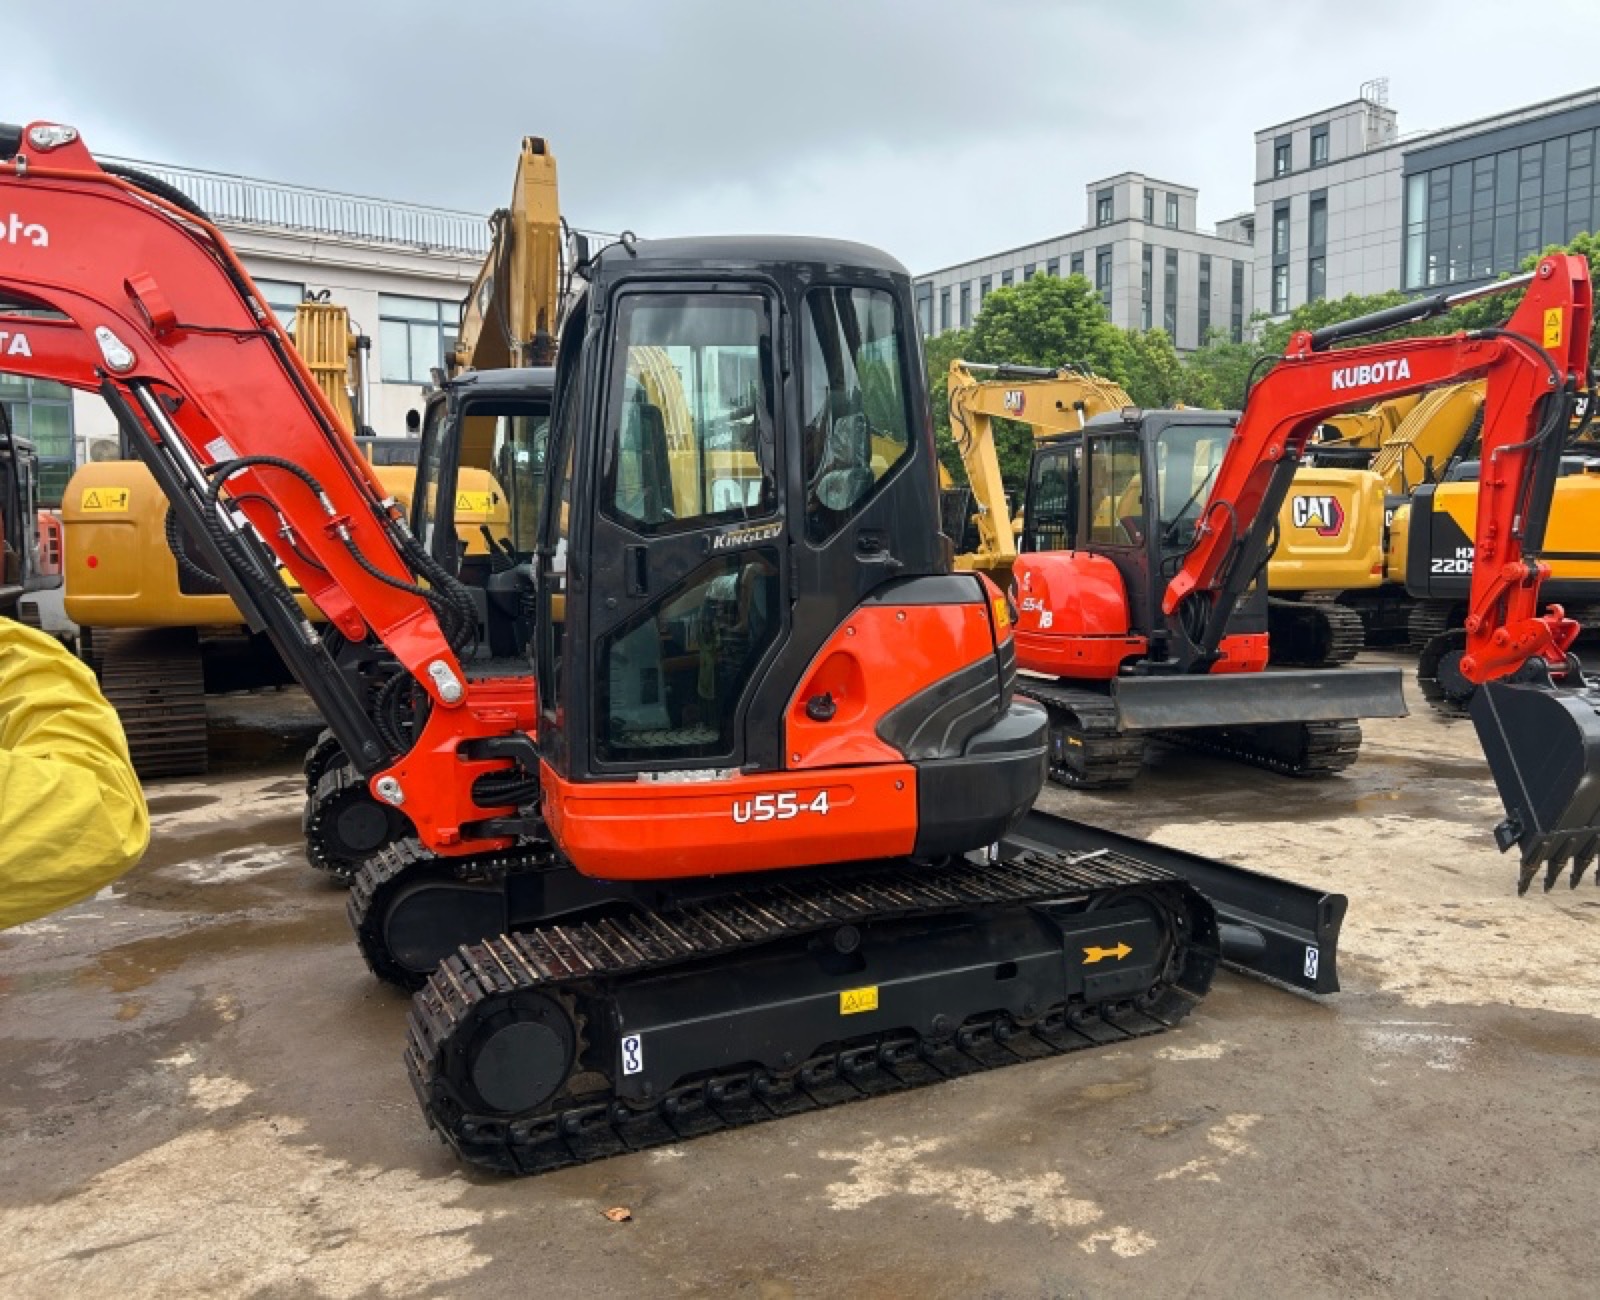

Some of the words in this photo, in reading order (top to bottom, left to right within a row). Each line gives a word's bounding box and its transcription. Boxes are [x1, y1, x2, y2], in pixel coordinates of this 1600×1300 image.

[1331, 357, 1411, 391] KUBOTA
[1004, 391, 1023, 409] CAT
[1293, 496, 1333, 527] CAT
